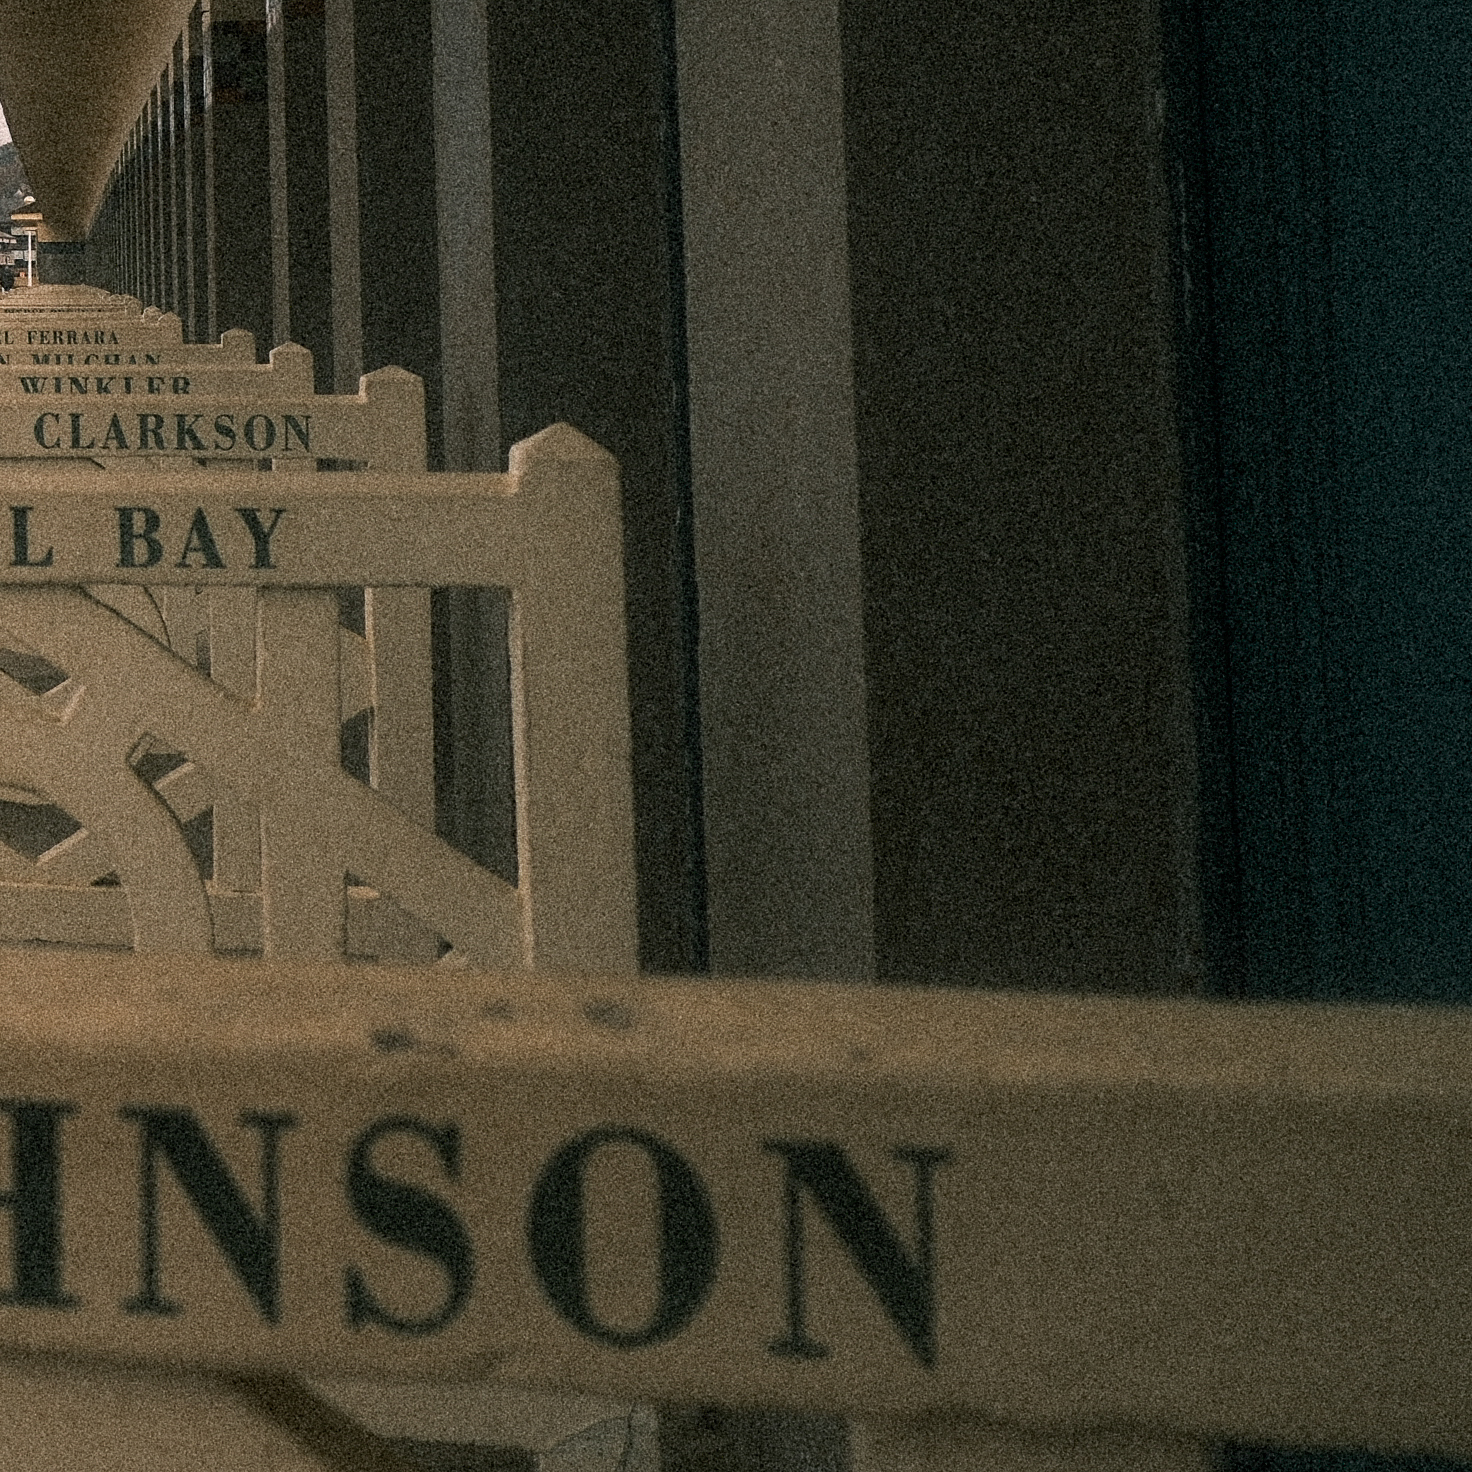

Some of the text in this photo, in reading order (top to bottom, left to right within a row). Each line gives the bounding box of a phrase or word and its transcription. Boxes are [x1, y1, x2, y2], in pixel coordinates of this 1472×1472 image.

[27, 330, 120, 345] FERRARA
[33, 412, 312, 452] CLARKSON
[114, 506, 288, 571] BAY
